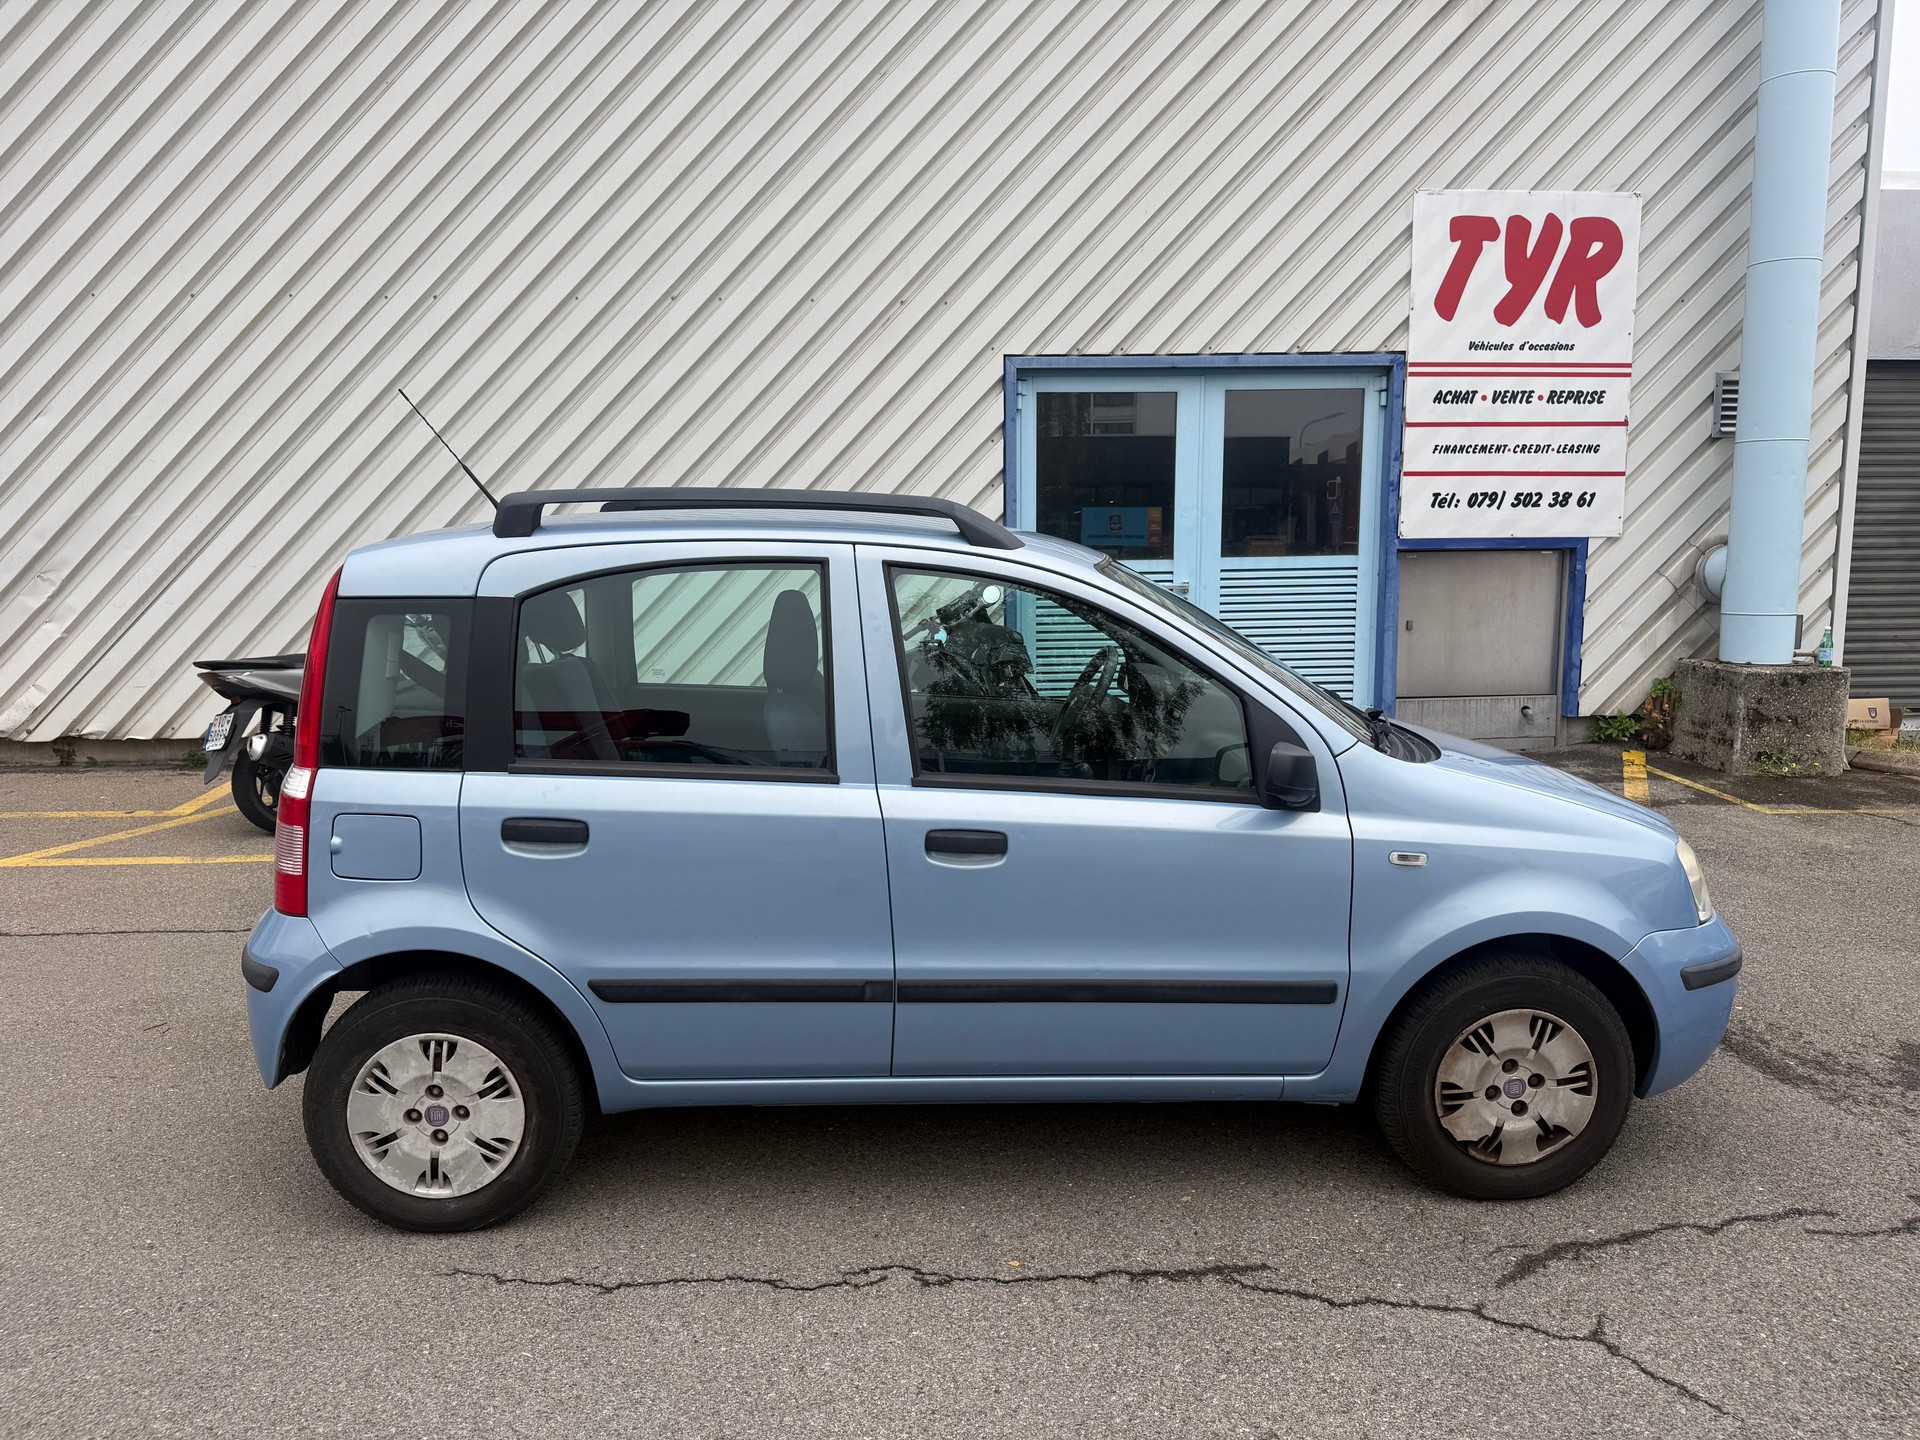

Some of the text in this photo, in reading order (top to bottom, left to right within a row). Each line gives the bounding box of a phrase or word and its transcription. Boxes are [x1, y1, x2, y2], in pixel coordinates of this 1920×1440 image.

[1434, 213, 1623, 328] TYR
[1469, 341, 1575, 351] Véhicules d'occasions
[1433, 390, 1606, 404] ACHAT VENTE REPRISE
[1433, 444, 1600, 454] FINANCEMENT CREDIT LEASING
[1431, 493, 1460, 508] Tél:
[1511, 492, 1543, 508] 502
[1548, 492, 1572, 508] 38
[1577, 491, 1596, 507] 61
[430, 1110, 444, 1121] FIAT
